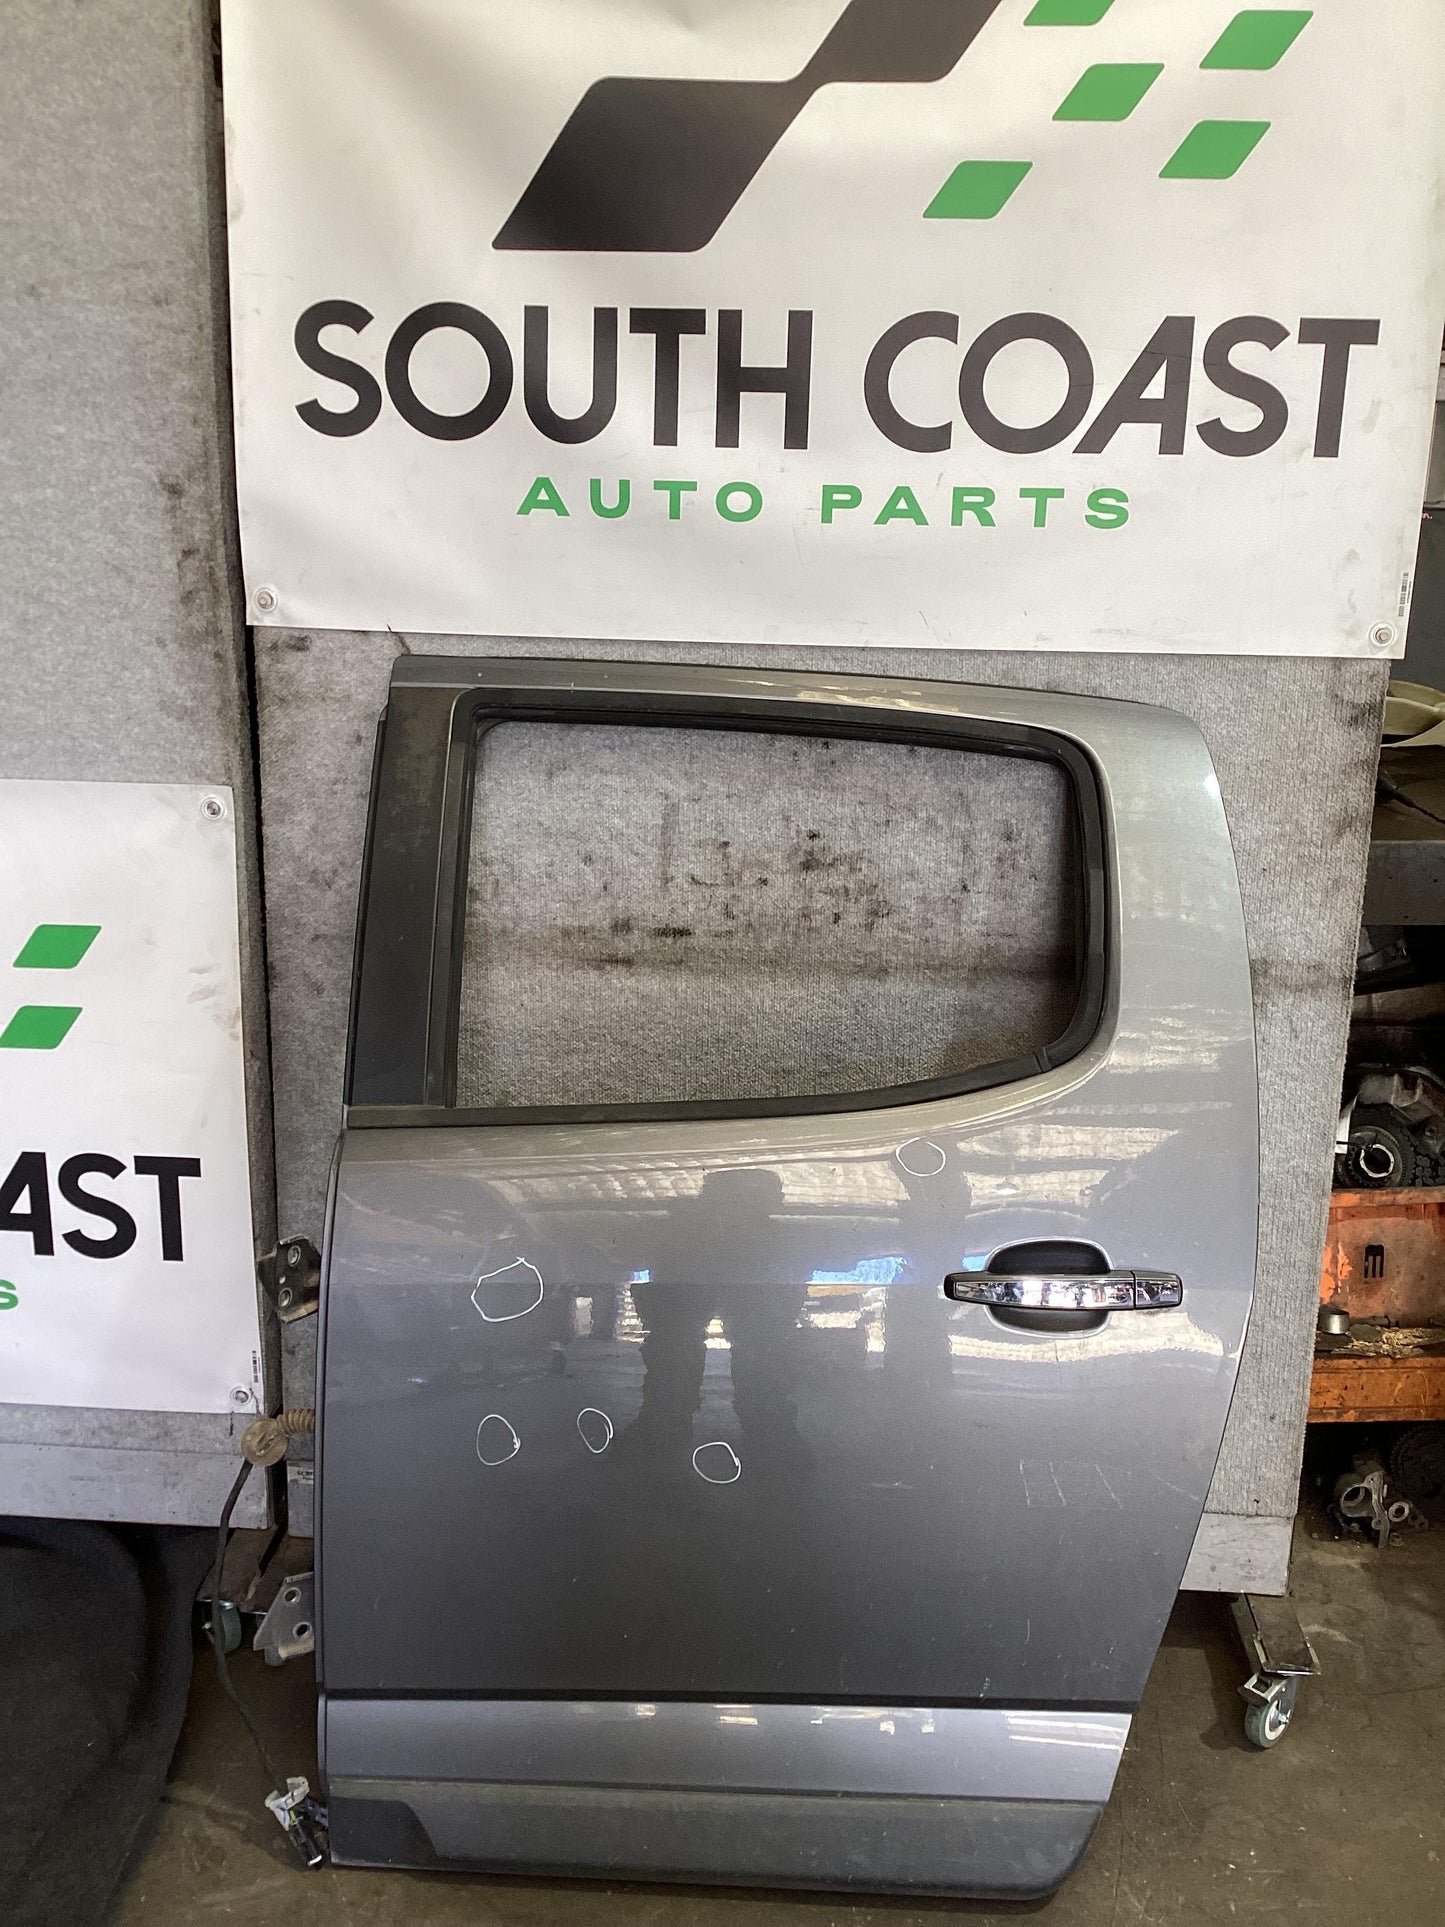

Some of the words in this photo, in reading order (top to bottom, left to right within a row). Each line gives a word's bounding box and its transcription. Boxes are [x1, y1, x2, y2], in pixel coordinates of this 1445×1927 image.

[295, 300, 813, 449] SOUTH
[864, 310, 1381, 458] COAST
[517, 476, 763, 523] AUTO
[821, 484, 1129, 530] PARTS
